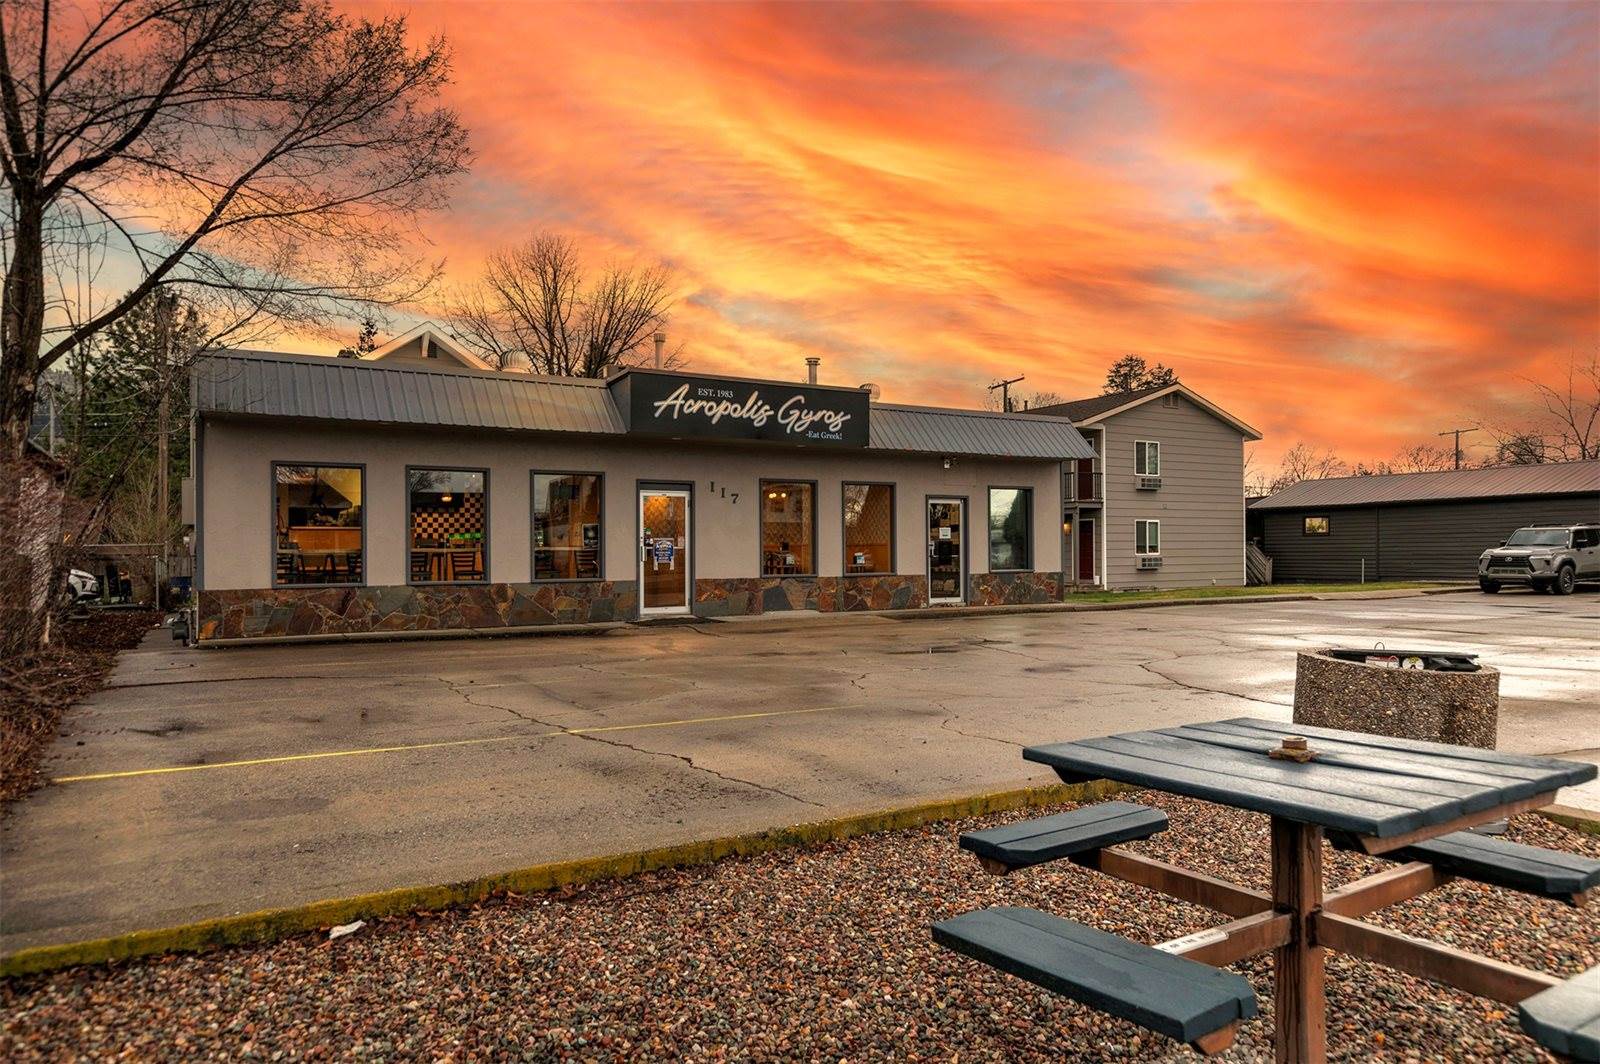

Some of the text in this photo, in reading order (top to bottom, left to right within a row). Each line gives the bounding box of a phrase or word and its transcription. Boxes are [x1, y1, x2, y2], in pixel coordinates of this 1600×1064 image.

[697, 387, 734, 399] EST. 1983
[653, 383, 851, 433] Acropolis Gyros
[709, 481, 739, 504] 117
